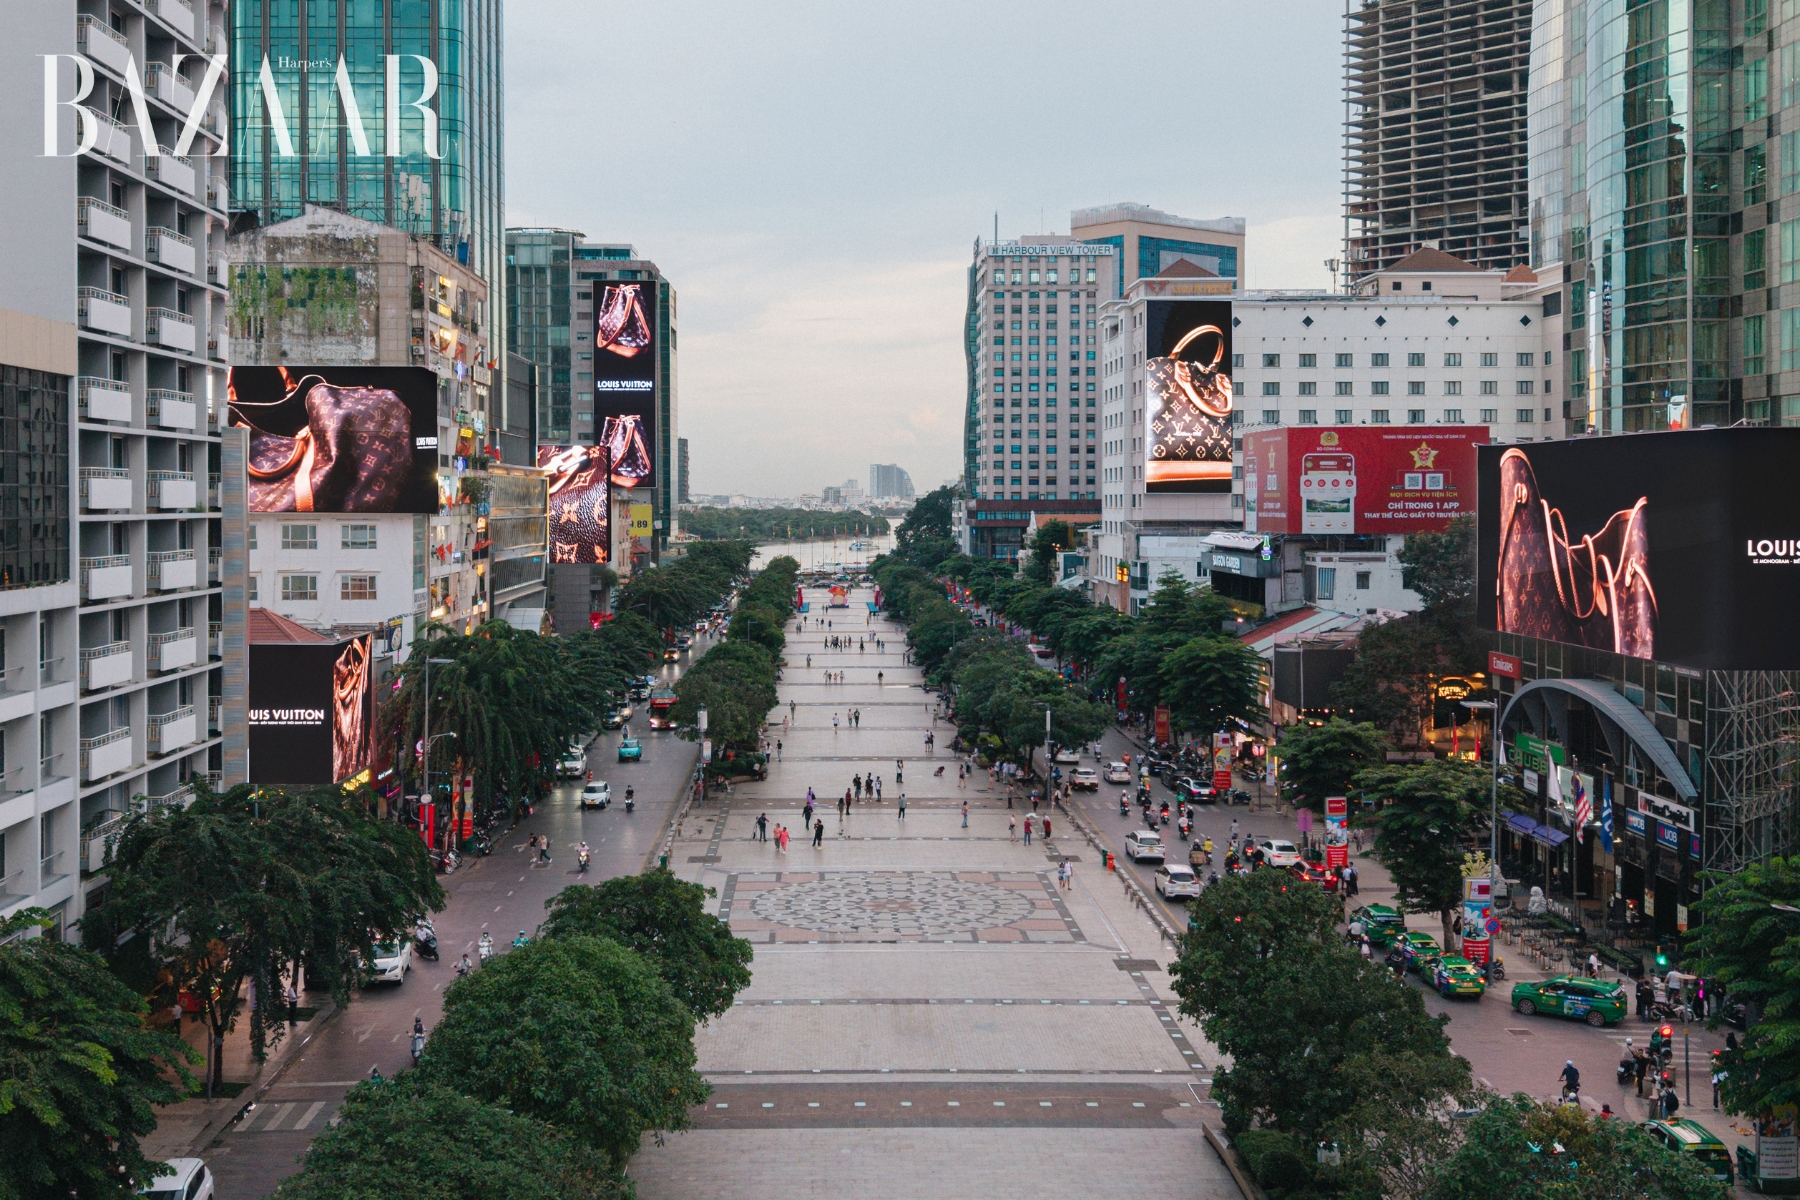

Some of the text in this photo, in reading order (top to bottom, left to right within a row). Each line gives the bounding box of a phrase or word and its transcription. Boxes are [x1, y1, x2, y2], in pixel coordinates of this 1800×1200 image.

[1001, 245, 1111, 255] HARBOUR VIEW TOWER
[1388, 501, 1404, 509] CHỈ
[1381, 511, 1393, 519] THẾ
[1409, 511, 1425, 519] GIẤY
[631, 520, 648, 528] .89
[1493, 657, 1514, 672] Emirates
[249, 709, 324, 720] UIS VUITTON
[1508, 748, 1547, 774] CHUBB
[1632, 815, 1645, 830] UOB
[1664, 826, 1678, 842] UOB
